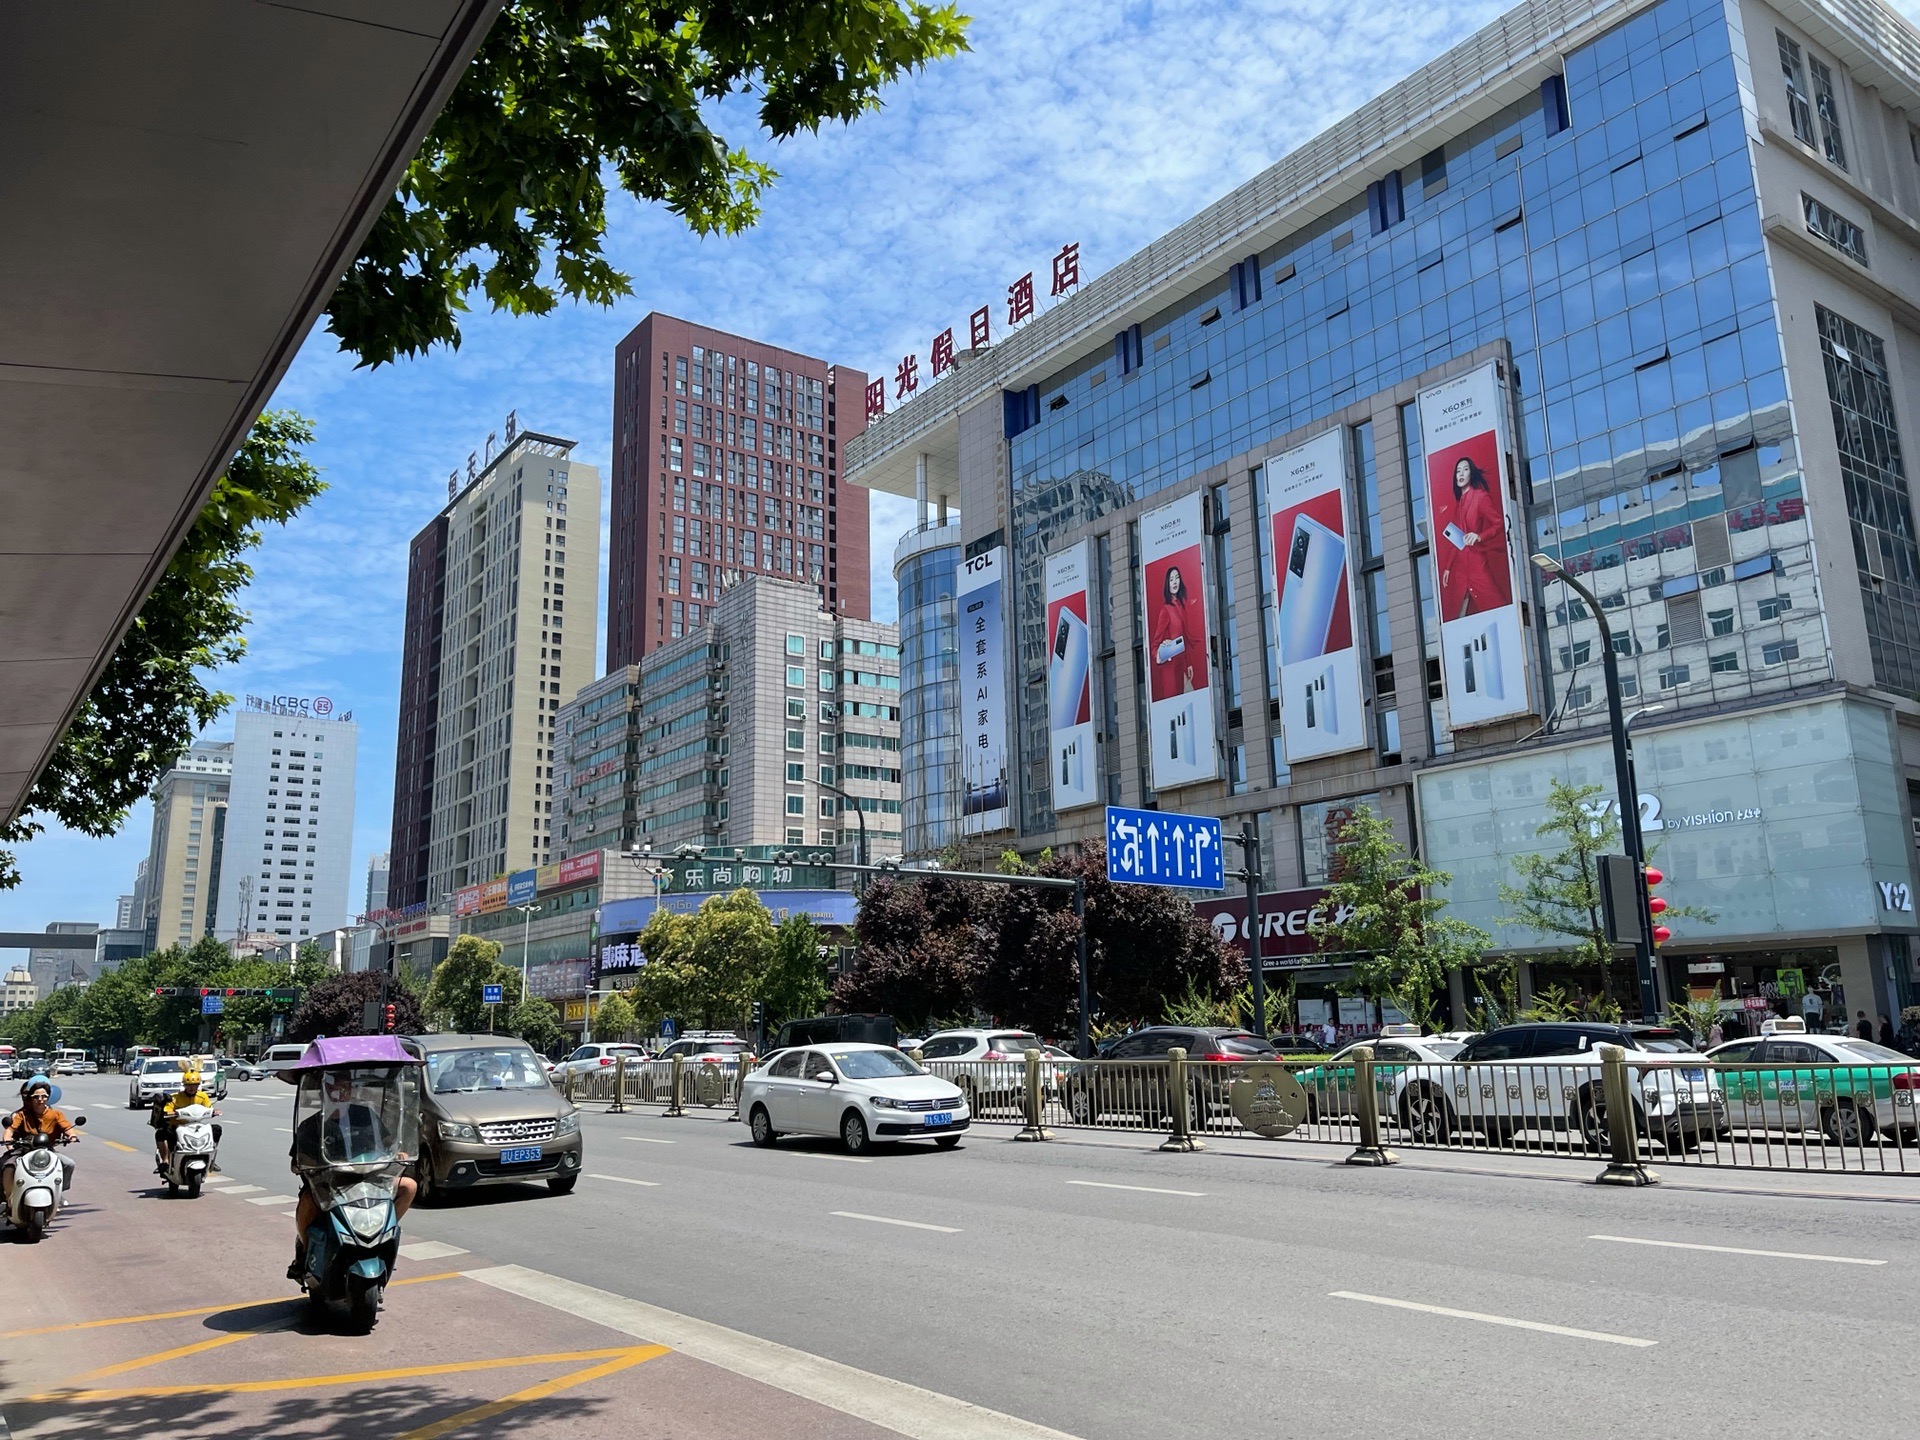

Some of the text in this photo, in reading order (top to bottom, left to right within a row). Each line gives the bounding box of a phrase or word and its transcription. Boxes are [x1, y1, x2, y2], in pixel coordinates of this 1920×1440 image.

[865, 242, 1079, 422] 阳光假日酒店
[965, 553, 993, 575] TCL
[975, 616, 989, 749] 全套系AI家电
[271, 694, 310, 709] ICBC
[1667, 818, 1681, 830] by
[685, 866, 793, 887] 乐尚购物
[1878, 881, 1912, 911] Y:2
[1241, 908, 1329, 939] GREE
[1262, 958, 1275, 967] Gree
